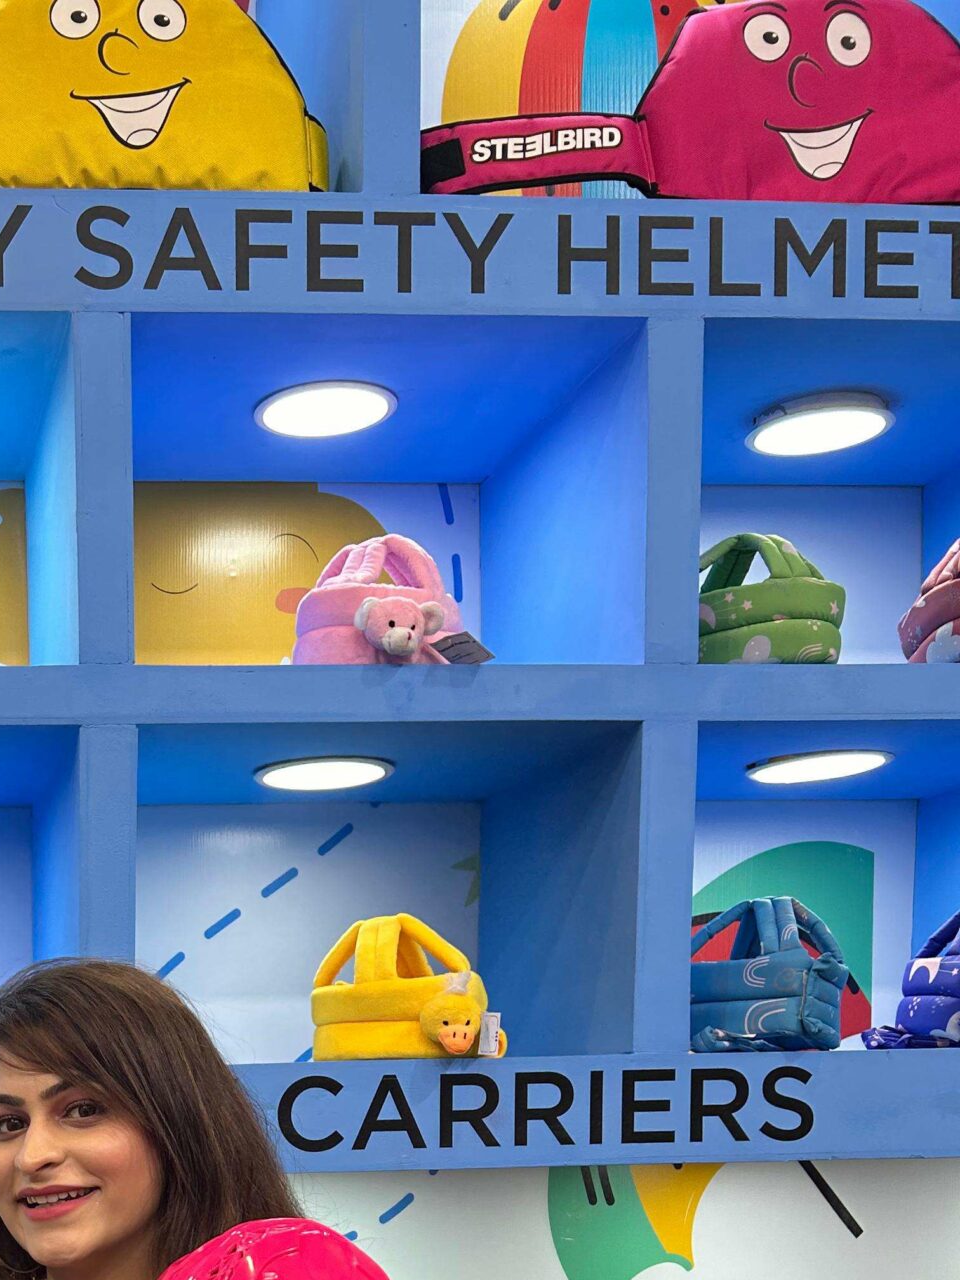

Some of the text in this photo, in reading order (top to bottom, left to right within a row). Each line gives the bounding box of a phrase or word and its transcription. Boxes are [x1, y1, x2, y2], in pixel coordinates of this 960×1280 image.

[471, 126, 622, 163] STEELBIRD
[73, 204, 514, 295] SAFETY
[277, 1065, 815, 1153] CARRIERS
